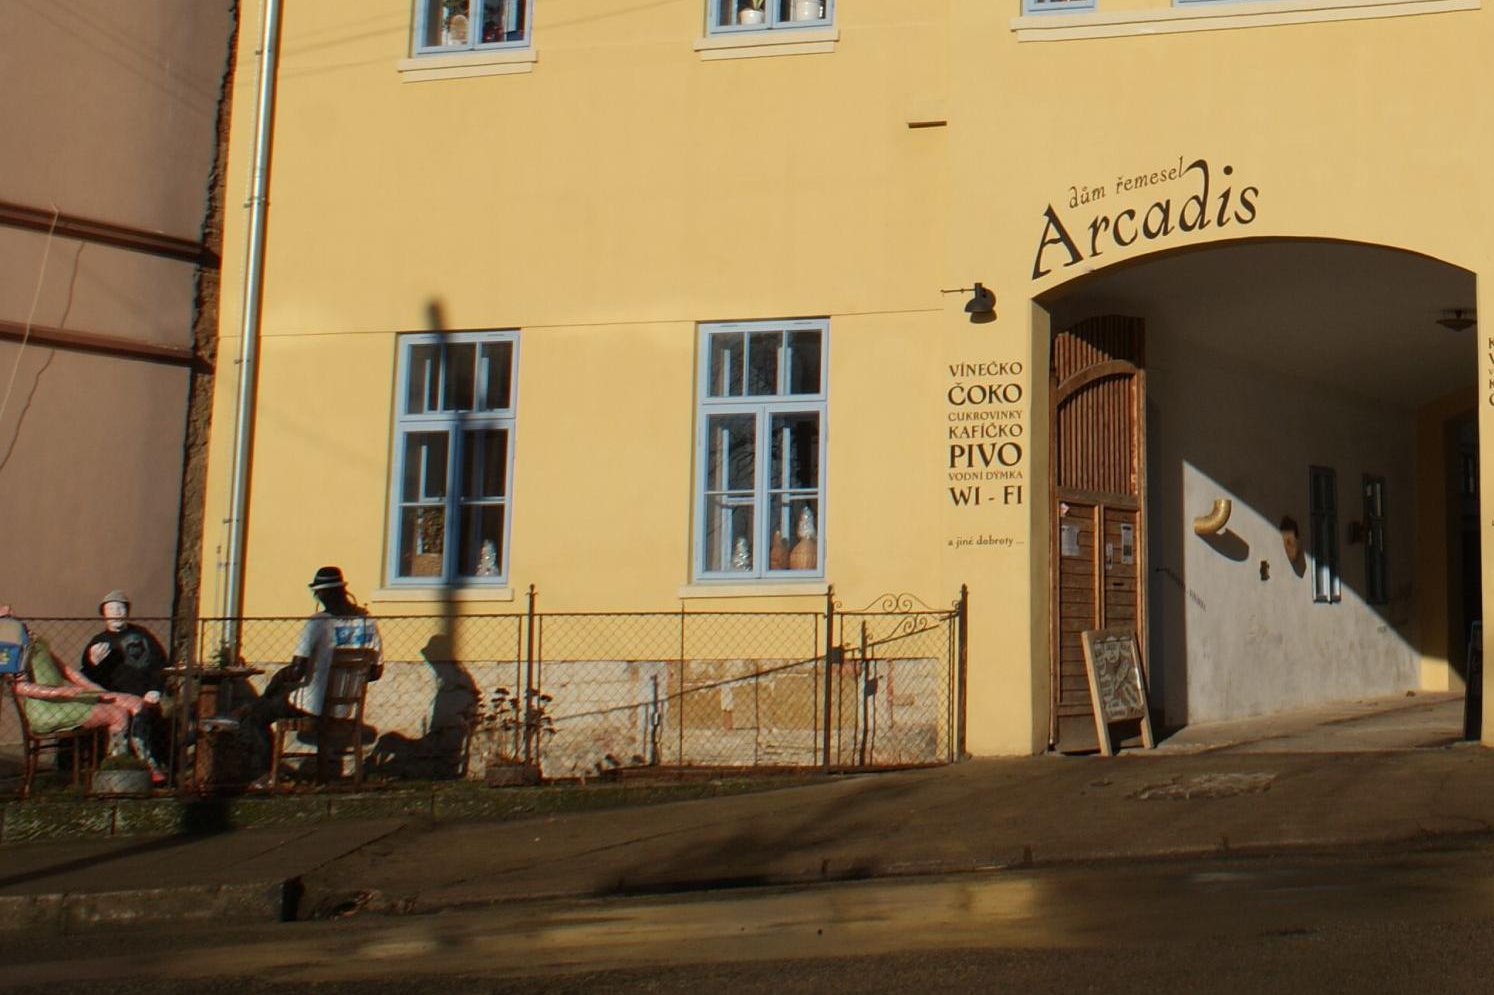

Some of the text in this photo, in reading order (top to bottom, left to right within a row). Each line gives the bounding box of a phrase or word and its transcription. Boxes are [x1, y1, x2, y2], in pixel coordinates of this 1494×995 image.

[1068, 155, 1184, 209] dům řemesel
[1031, 158, 1260, 281] Arcadis
[948, 360, 1023, 377] VÍNEČKO
[947, 381, 1023, 406] ČOKO
[948, 409, 1023, 422] CUKROVINKY
[948, 422, 1023, 440] KAFÍČKO
[949, 441, 1023, 468] PIVO
